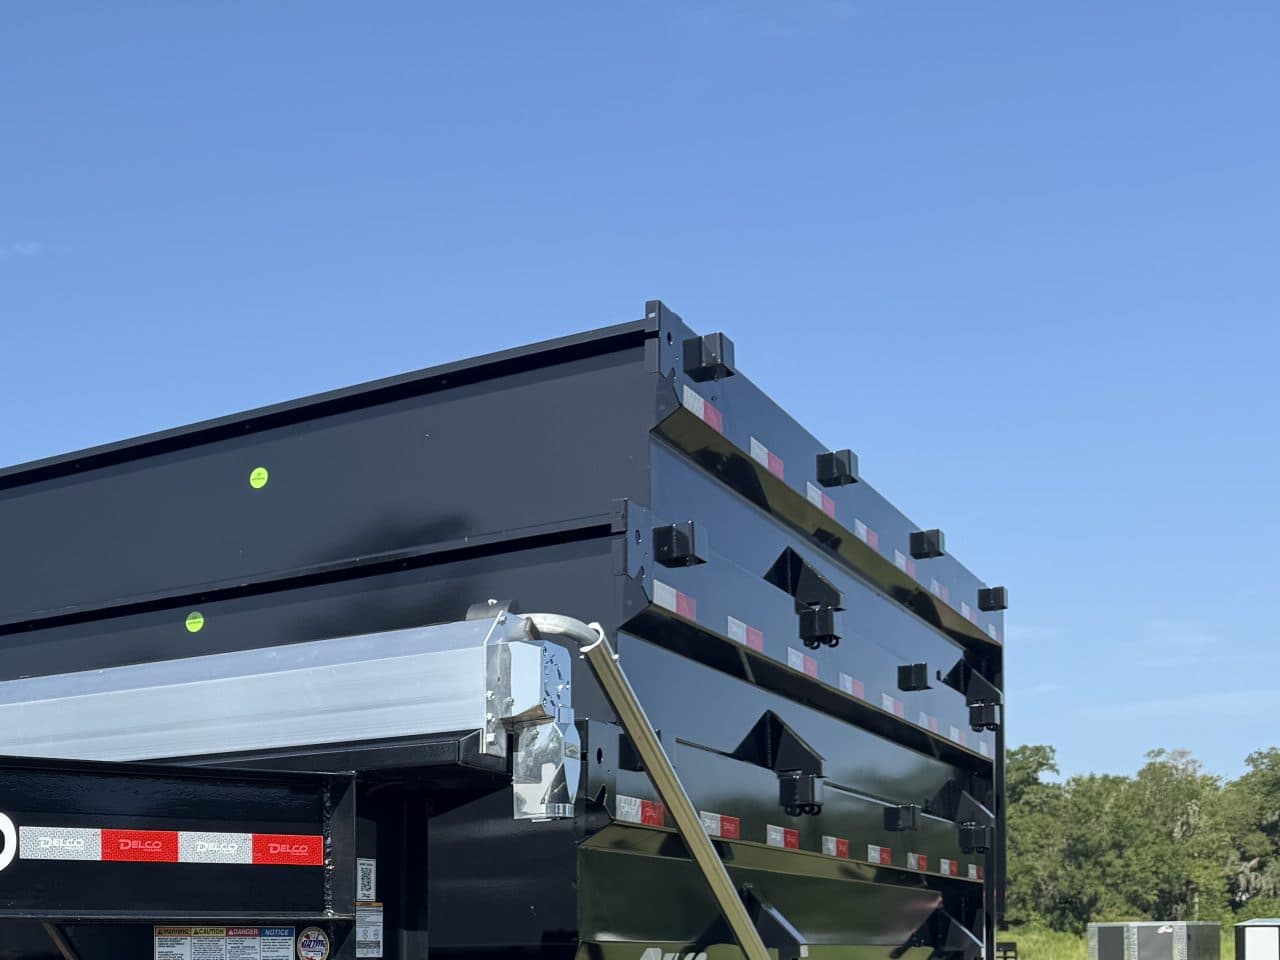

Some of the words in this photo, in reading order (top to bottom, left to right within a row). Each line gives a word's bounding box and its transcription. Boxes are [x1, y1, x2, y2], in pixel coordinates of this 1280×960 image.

[118, 839, 161, 850] DELCO
[268, 843, 308, 854] DELCO
[265, 928, 289, 936] NOTICE
